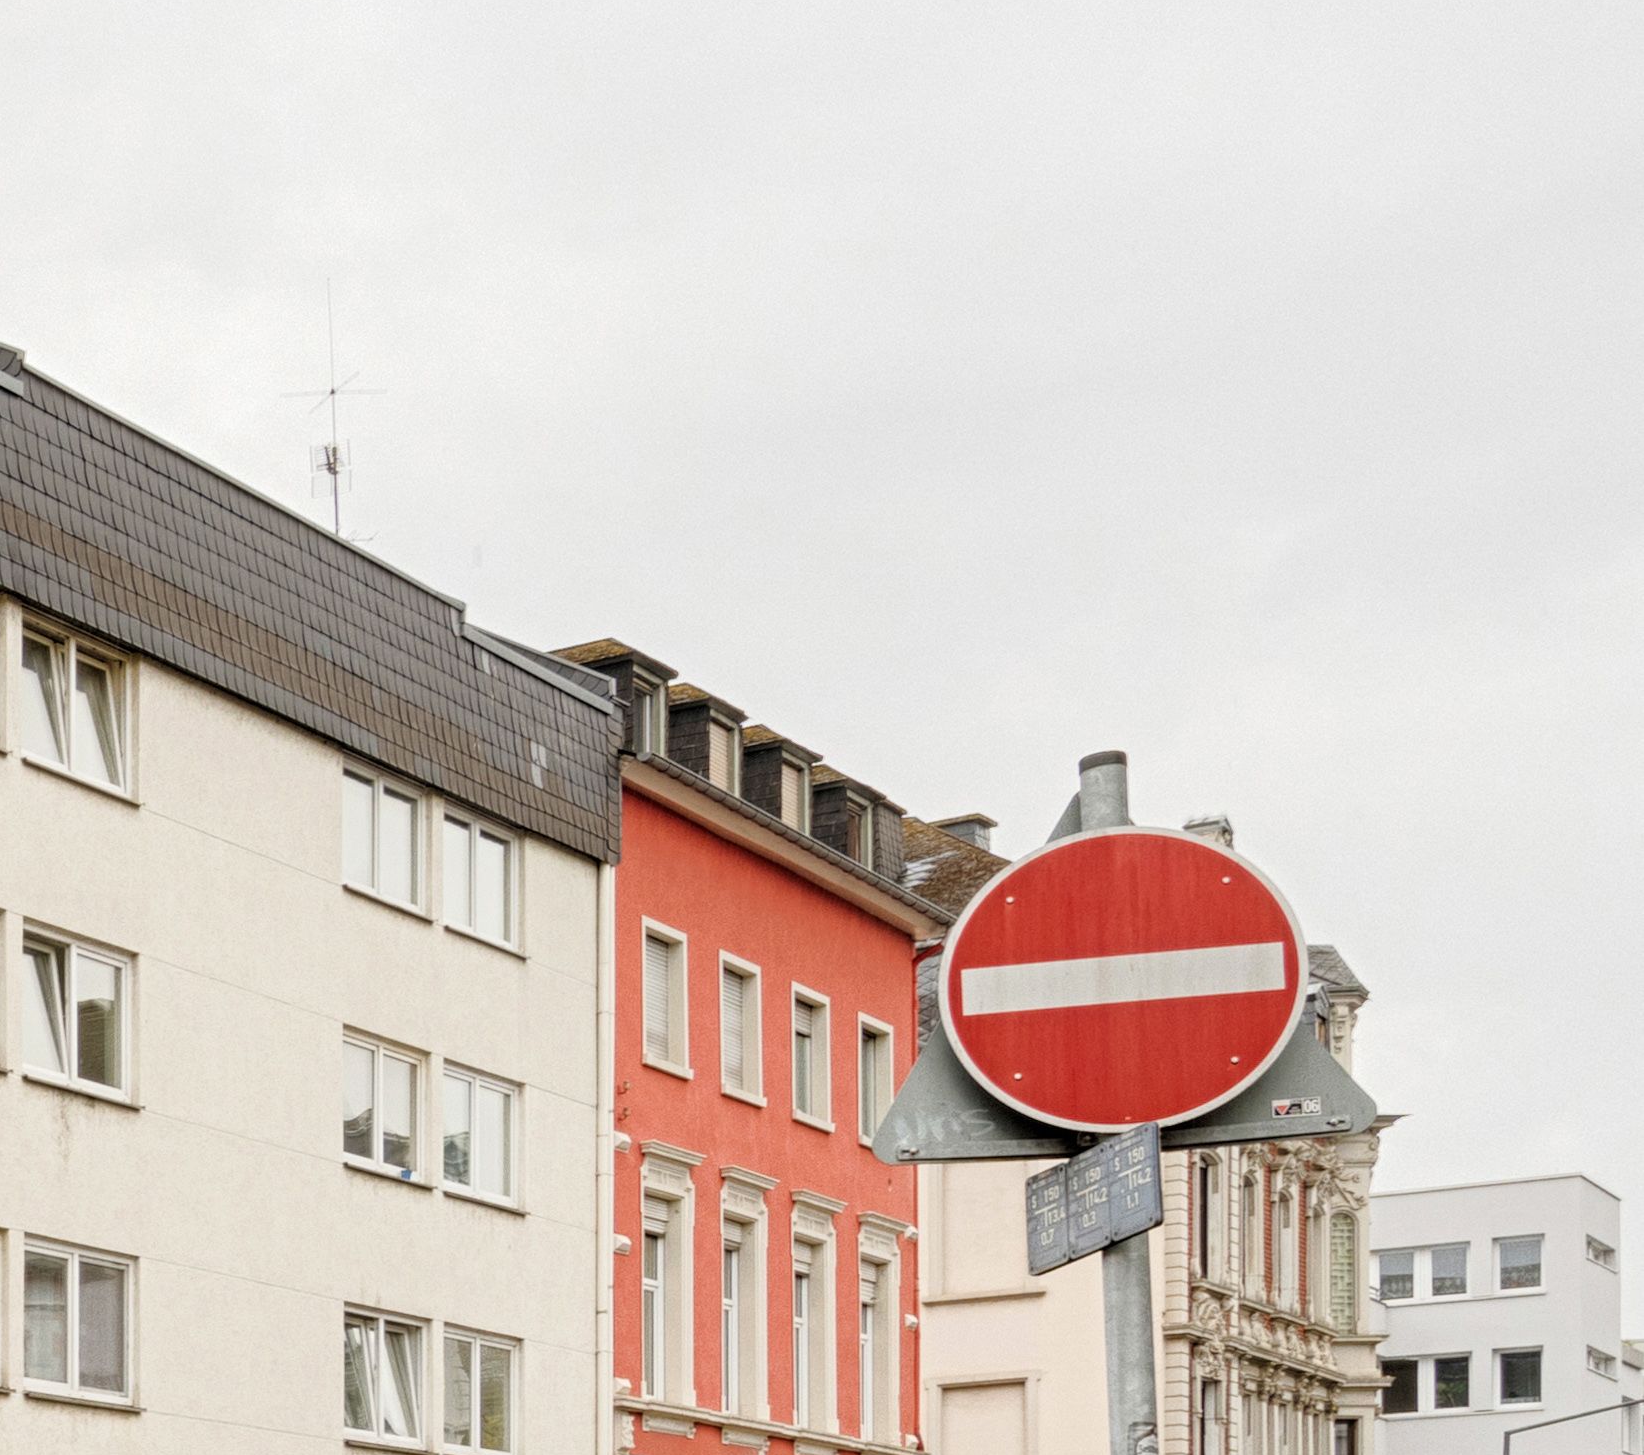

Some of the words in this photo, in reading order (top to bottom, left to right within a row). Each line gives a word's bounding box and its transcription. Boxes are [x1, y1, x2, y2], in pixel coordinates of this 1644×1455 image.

[1128, 1146, 1145, 1165] 150
[1085, 1166, 1101, 1186] 150
[1043, 1185, 1060, 1203] 150
